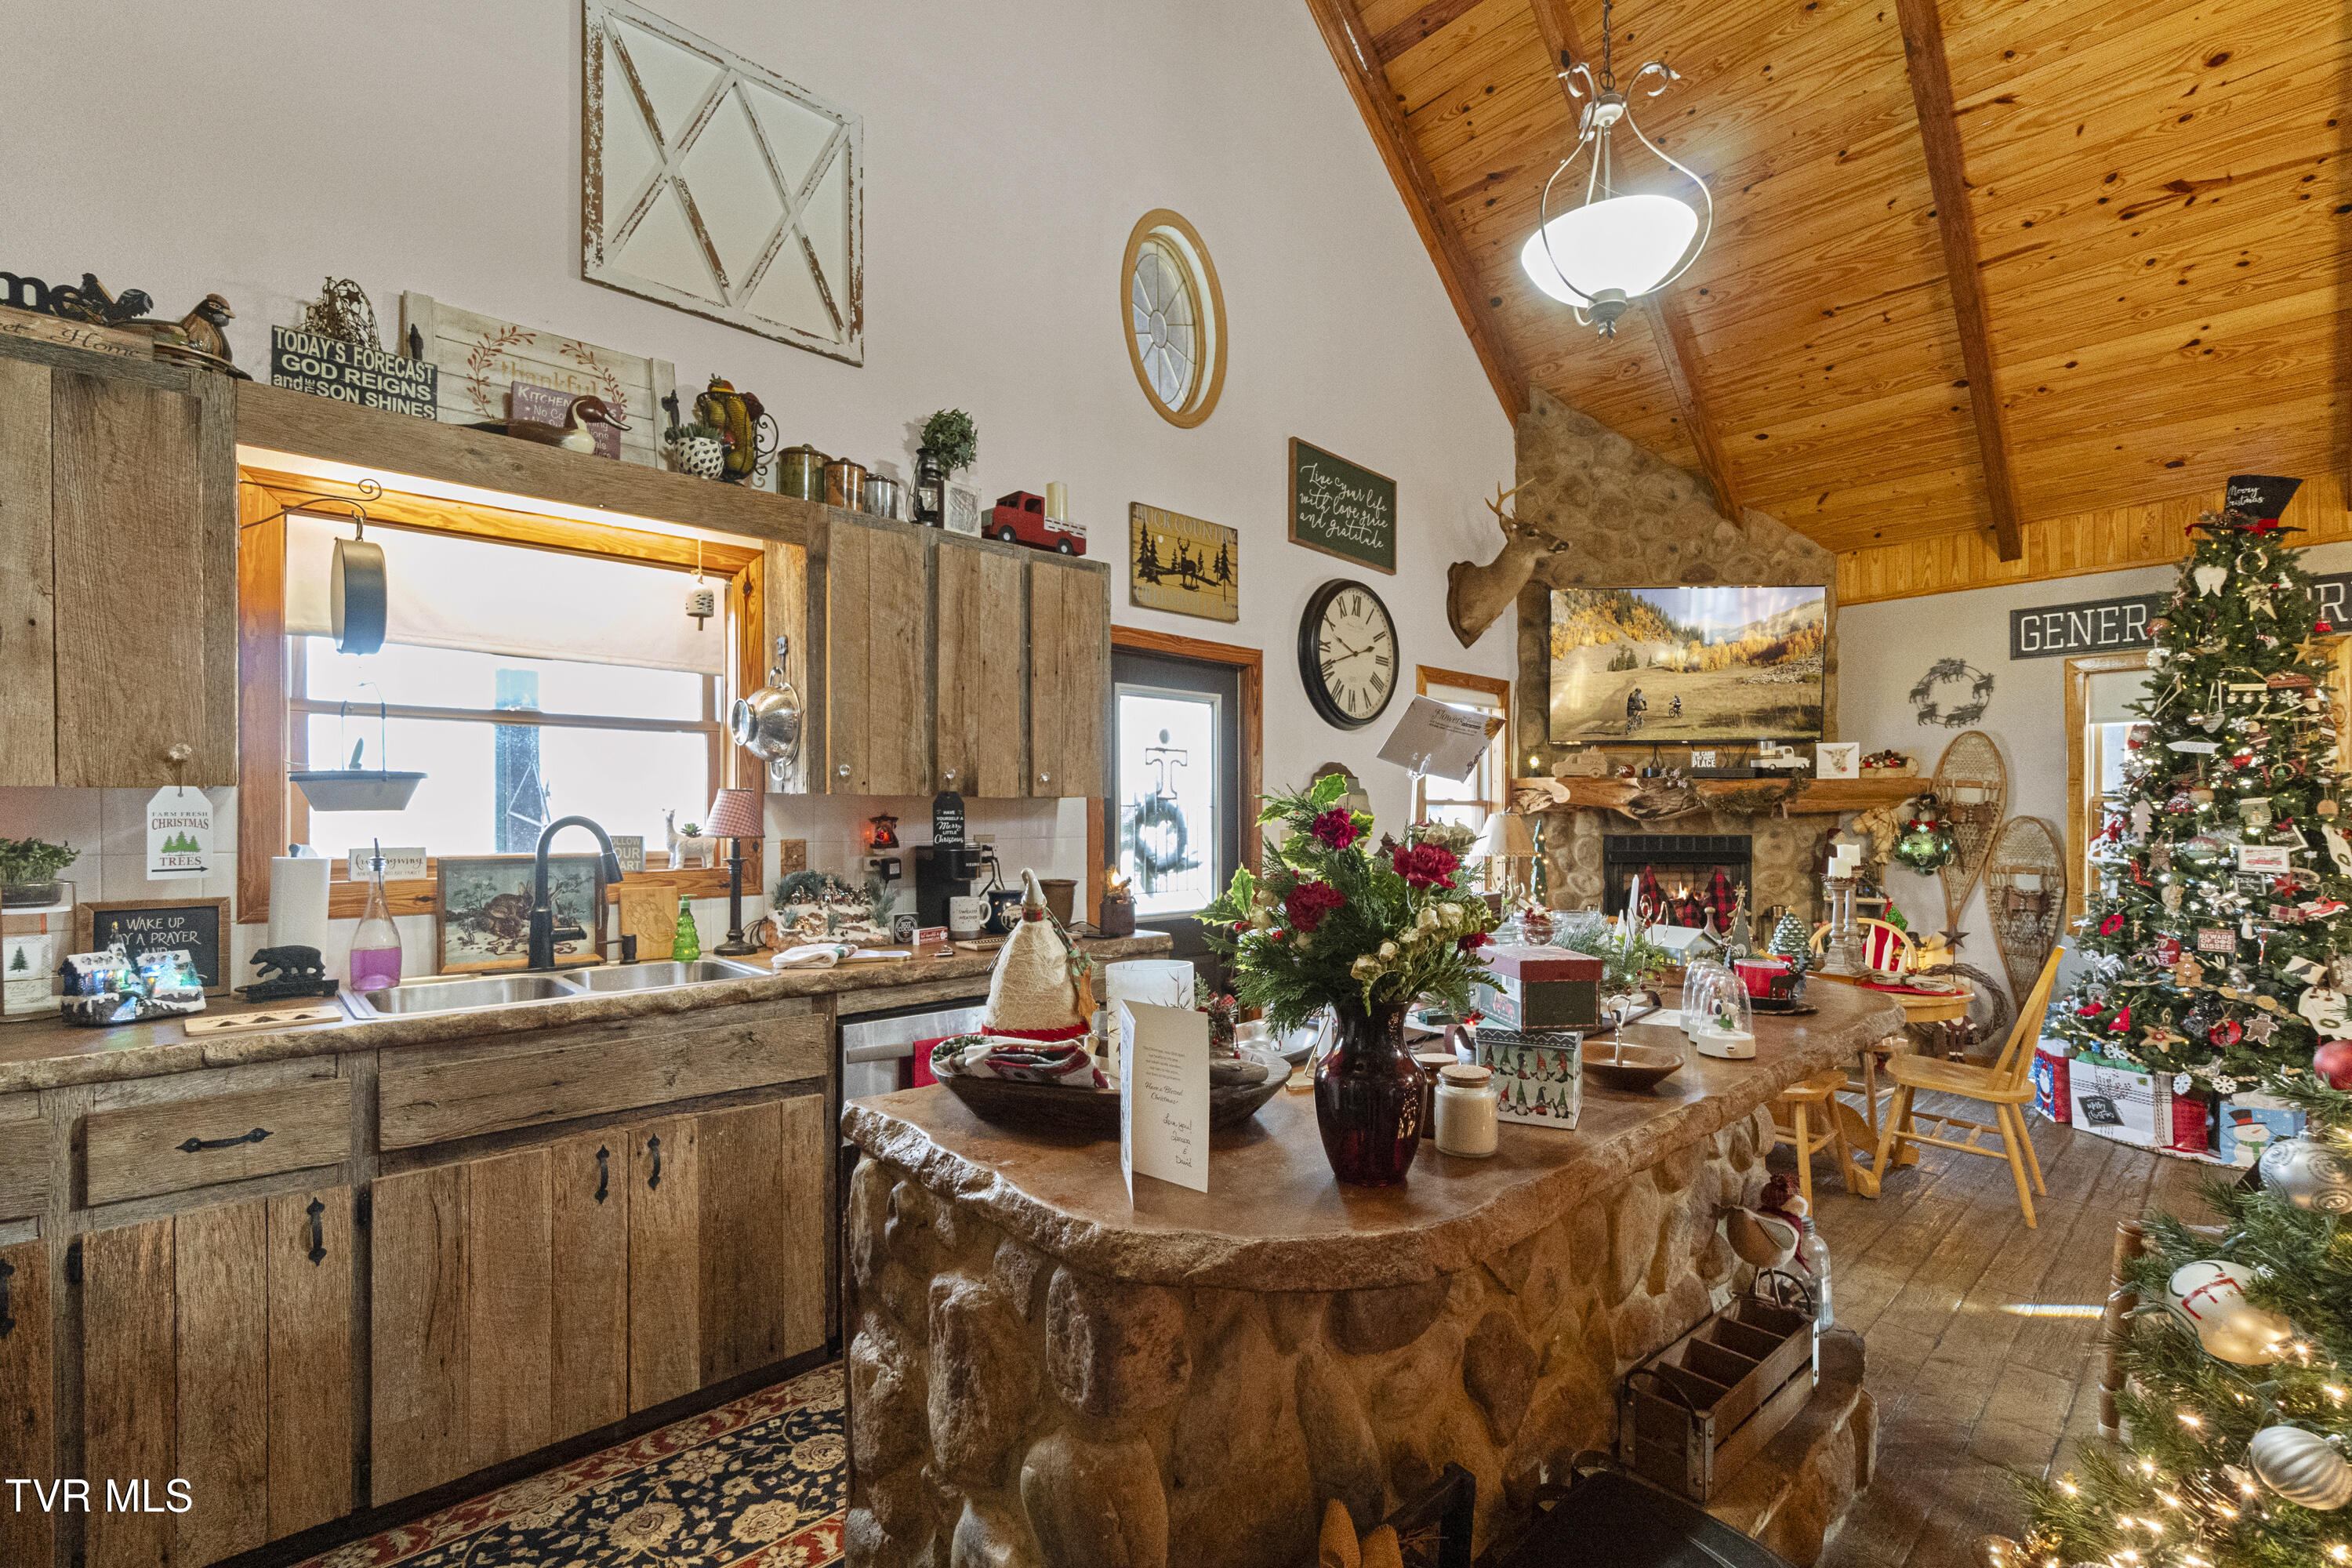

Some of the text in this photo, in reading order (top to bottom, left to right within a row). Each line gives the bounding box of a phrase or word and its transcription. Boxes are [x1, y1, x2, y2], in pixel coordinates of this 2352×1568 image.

[274, 328, 434, 385] TODAY'S FORECAST
[281, 354, 431, 401] GOD REIGNS
[274, 374, 436, 420] and THE SON SHINES
[534, 405, 548, 417] No
[1300, 488, 1333, 514] with
[1334, 477, 1365, 500] your
[1367, 488, 1387, 519] life
[1136, 504, 1237, 544] BUCK COUNTRY
[1300, 512, 1327, 528] and
[2020, 603, 2149, 652] GENER
[1431, 708, 1463, 724] Flowers
[151, 818, 209, 830] CHRISTMAS
[936, 821, 963, 832] Merry
[934, 833, 964, 844] Christmas
[614, 847, 641, 859] OUR
[159, 856, 201, 866] TREES
[619, 860, 641, 871] ART
[126, 916, 185, 931] WAKE UP
[136, 934, 146, 946] A
[151, 931, 201, 946] PRAYER
[1163, 1085, 1184, 1097] Blessed
[1163, 1112, 1178, 1127] Love
[1175, 1155, 1192, 1168] David
